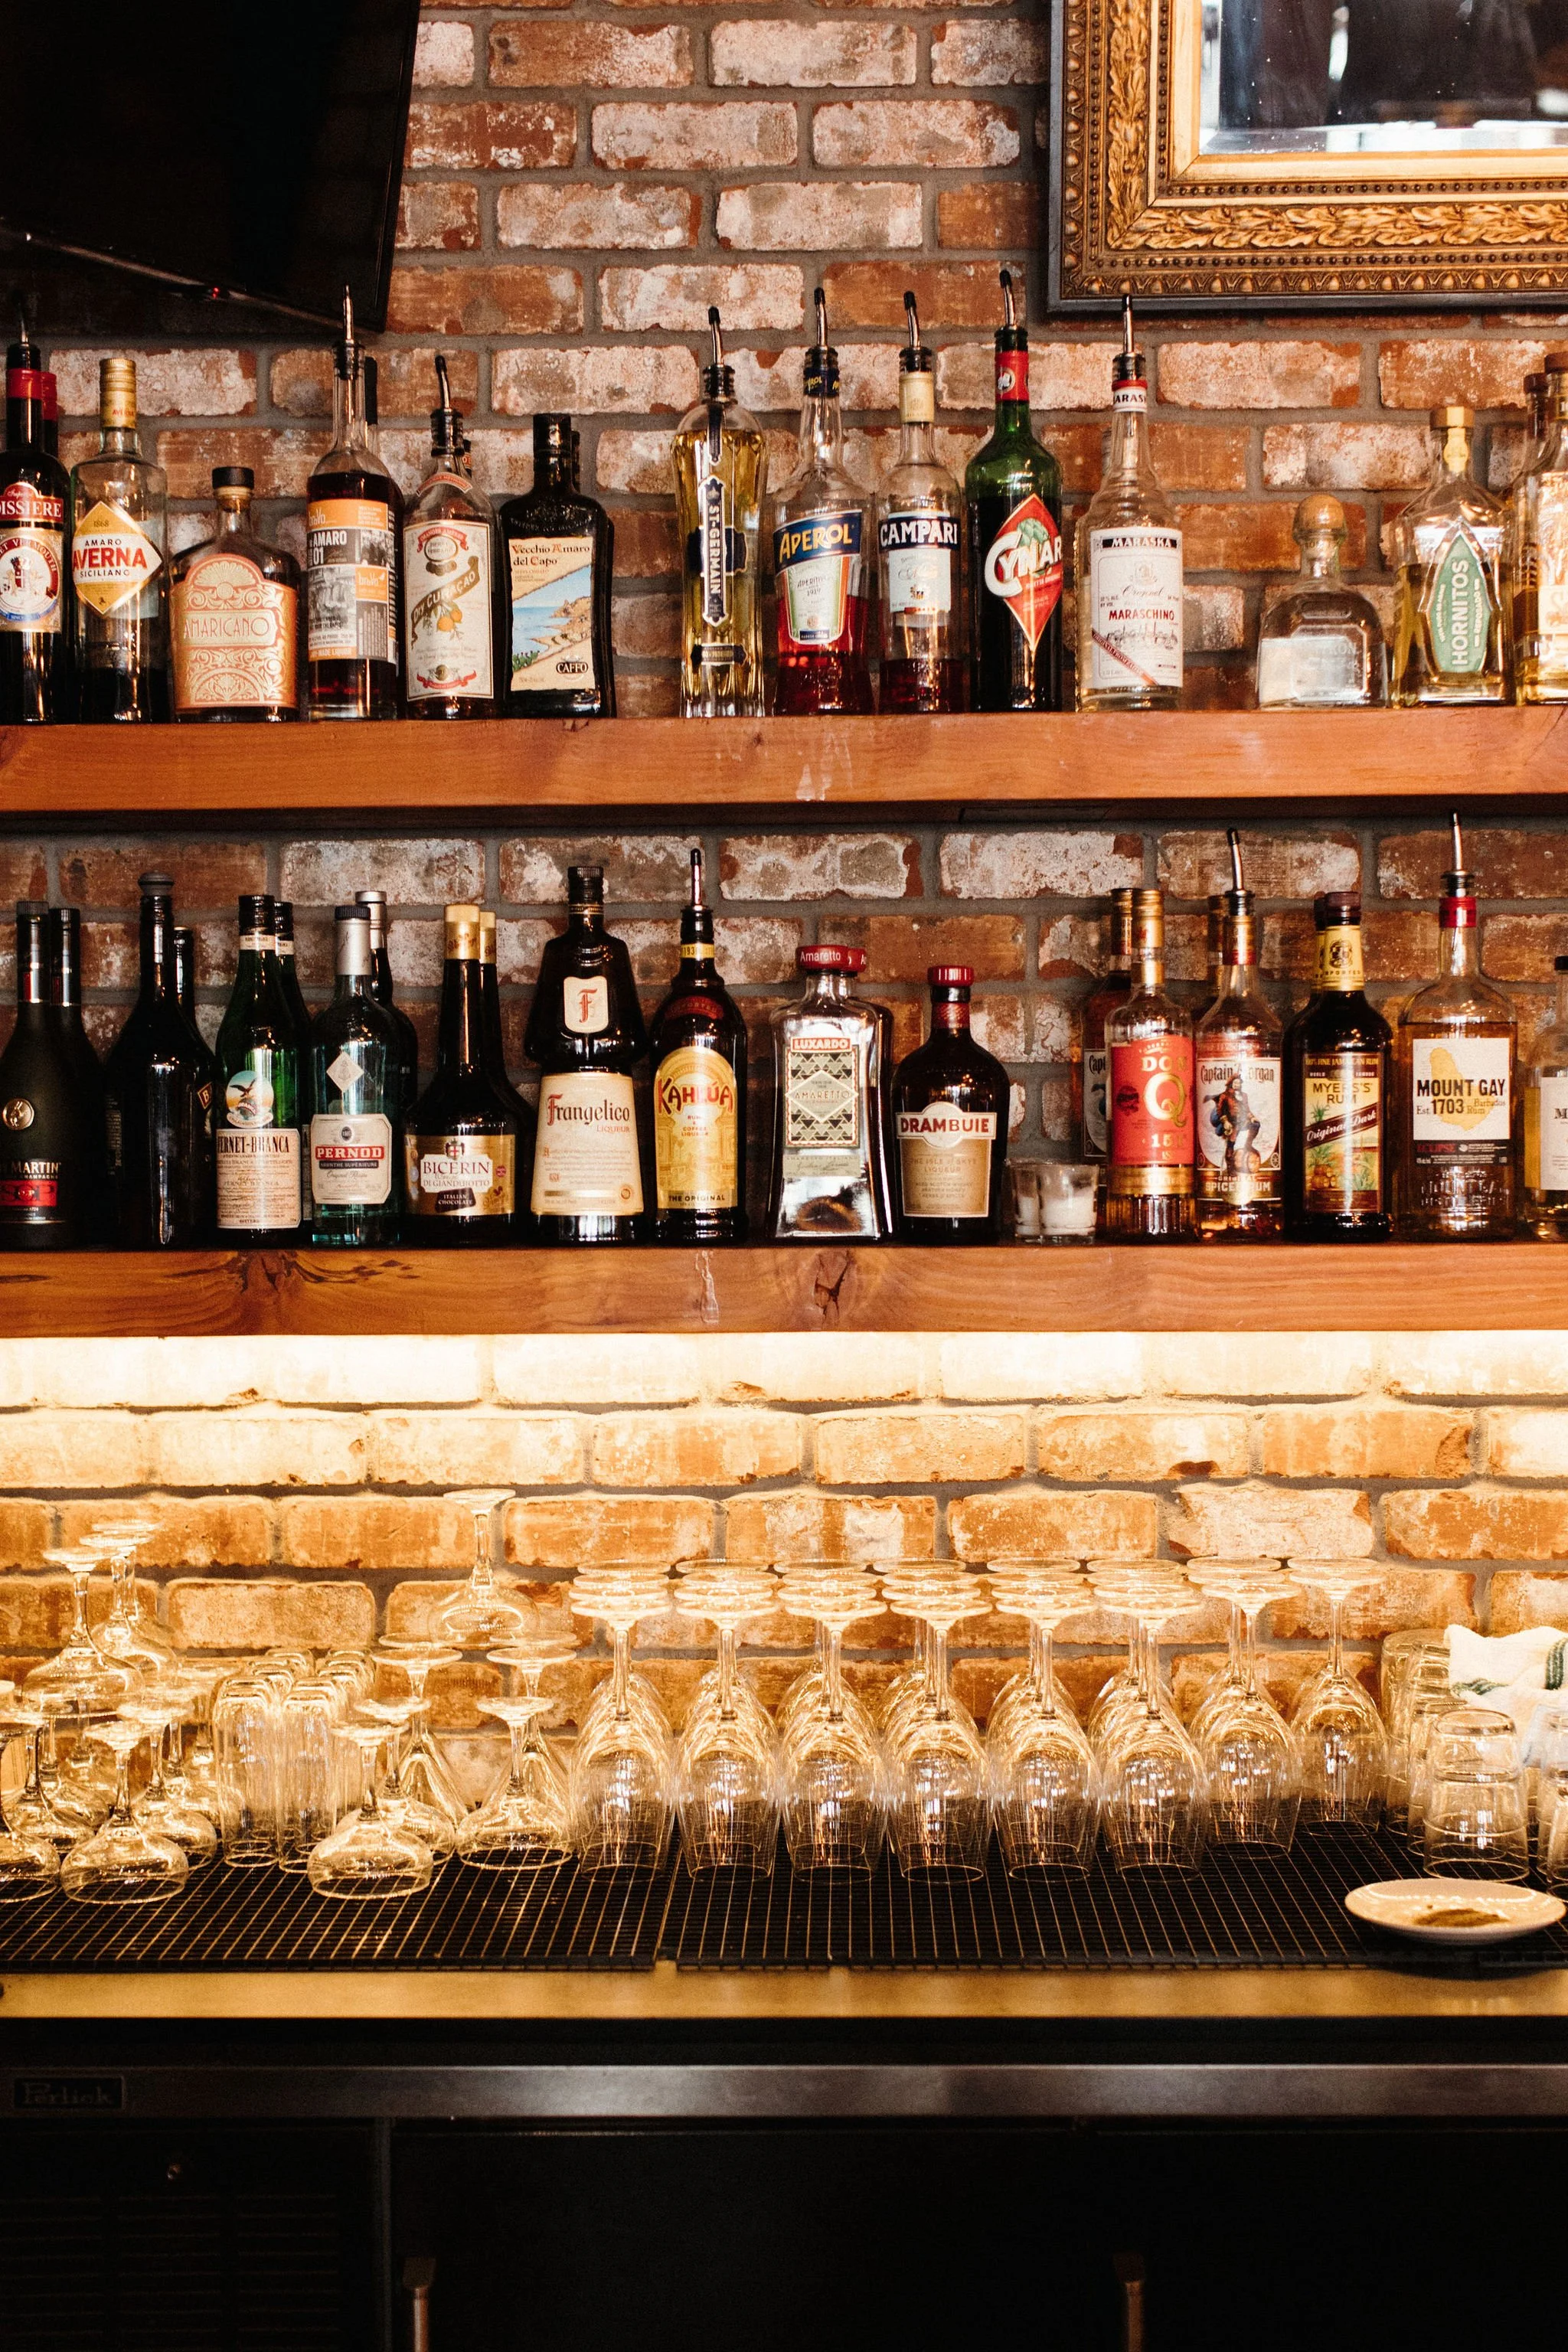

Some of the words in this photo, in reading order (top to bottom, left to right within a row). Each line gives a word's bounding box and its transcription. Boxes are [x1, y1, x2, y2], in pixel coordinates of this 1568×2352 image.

[0, 499, 62, 518] ISSIERE
[313, 530, 348, 547] AMARO
[880, 519, 958, 547] CAMPARI
[84, 538, 122, 547] AMARO
[511, 544, 550, 554] Vecchio
[709, 505, 721, 595] ST-GERMAIN
[779, 523, 853, 564] APEROL
[1111, 537, 1172, 548] MARASKA
[73, 545, 148, 572] AVERNA
[313, 547, 324, 565] 01
[513, 557, 528, 566] del
[530, 556, 557, 567] Capo
[985, 530, 1063, 598] CYNAR
[80, 568, 130, 578] SICILIANO
[426, 570, 475, 607] CUÇAO
[1109, 609, 1175, 622] MARASCHINO
[1451, 559, 1470, 666] HORNITOS
[183, 617, 270, 638] AMARICANO
[557, 662, 587, 673] CAFFO
[683, 946, 698, 956] 193
[800, 951, 841, 962] Amaretto
[577, 988, 598, 1024] F
[794, 1039, 849, 1050] LUXARDO
[1141, 1056, 1187, 1072] DON
[1331, 1057, 1365, 1066] JAMCAN
[1200, 1064, 1233, 1085] Captain
[1234, 1063, 1275, 1085] organ
[658, 1077, 733, 1115] KAHLÚA
[795, 1090, 851, 1099] AMARETTO
[1416, 1079, 1475, 1097] MOUNT
[1478, 1079, 1506, 1096] GAY
[1142, 1071, 1189, 1128] Q
[1431, 1099, 1465, 1115] 1703
[1466, 1105, 1486, 1115] Rum
[547, 1093, 630, 1126] Frangelico
[596, 1125, 631, 1133] LIQUEUR
[900, 1117, 990, 1133] DRAMBUIE
[1306, 1123, 1346, 1142] Original
[1351, 1109, 1377, 1128] Dark
[317, 1147, 383, 1158] PERNOD
[12, 1161, 59, 1174] MARTIN
[423, 1161, 490, 1174] BICERIN
[1205, 1181, 1242, 1192] SPICE
